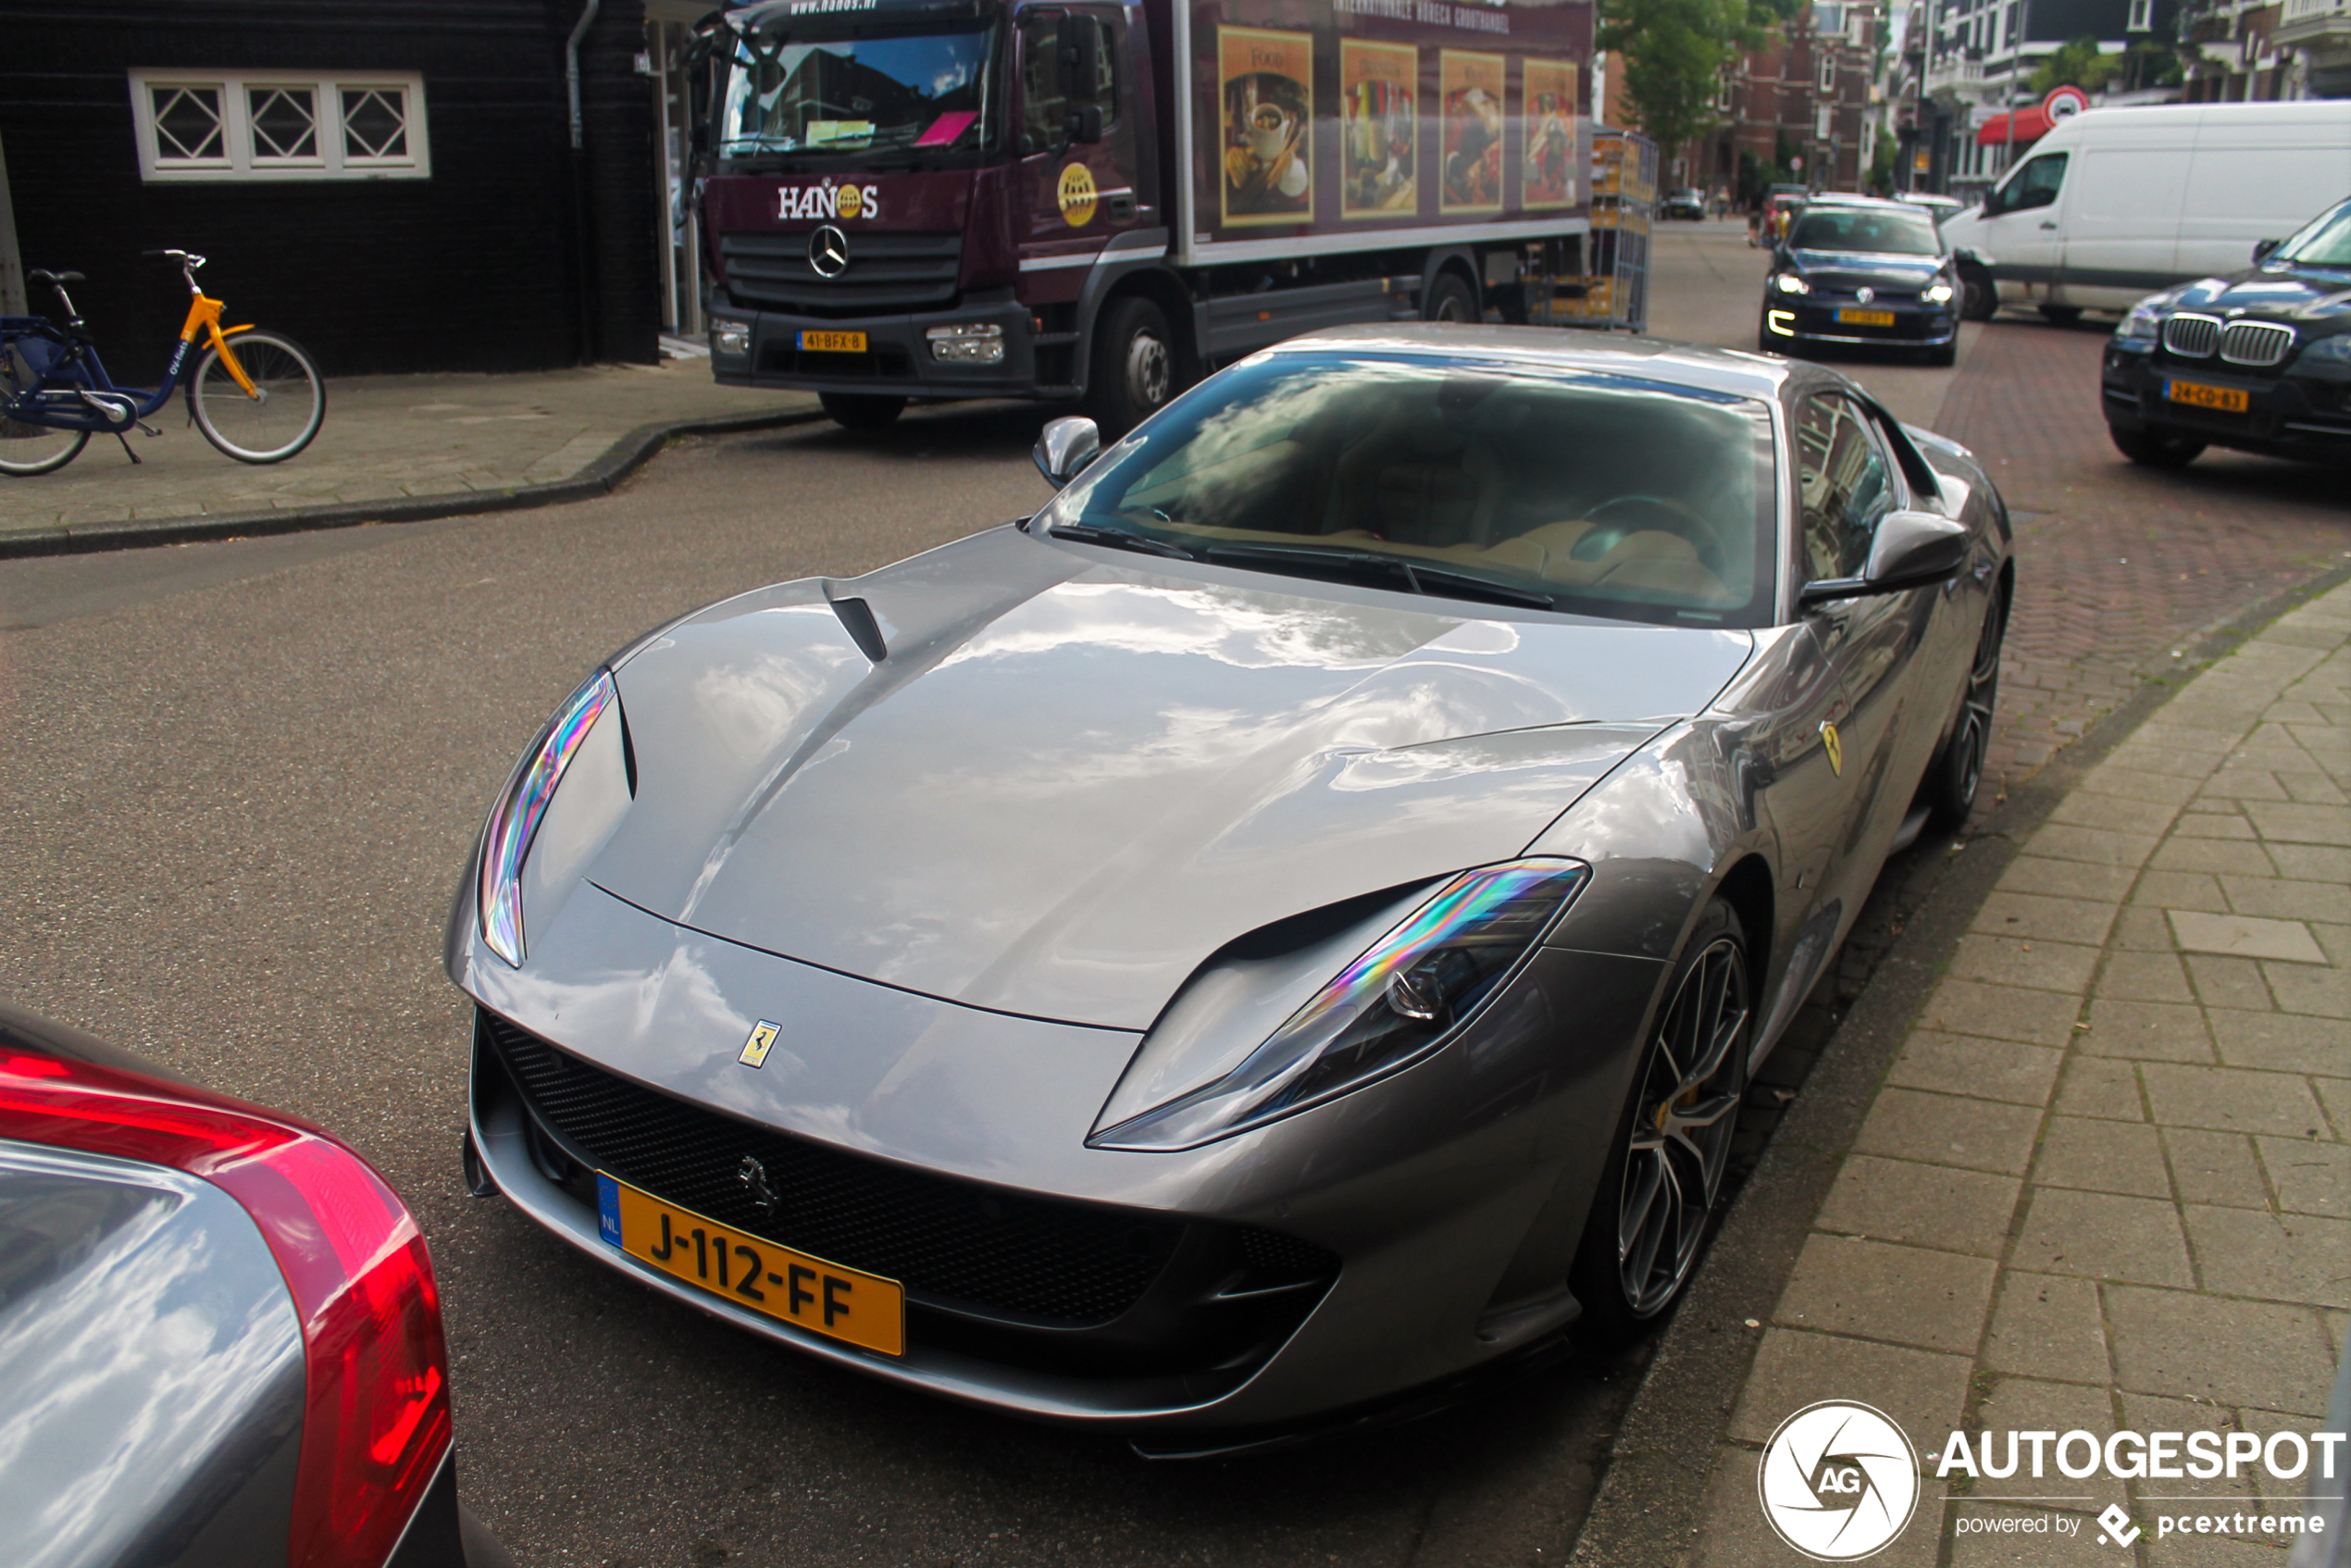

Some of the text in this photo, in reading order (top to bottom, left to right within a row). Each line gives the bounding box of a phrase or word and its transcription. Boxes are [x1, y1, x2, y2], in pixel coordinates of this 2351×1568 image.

[806, 333, 860, 349] 41-BFX-8
[603, 1213, 619, 1236] NL
[651, 1213, 852, 1327] J-112-FF
